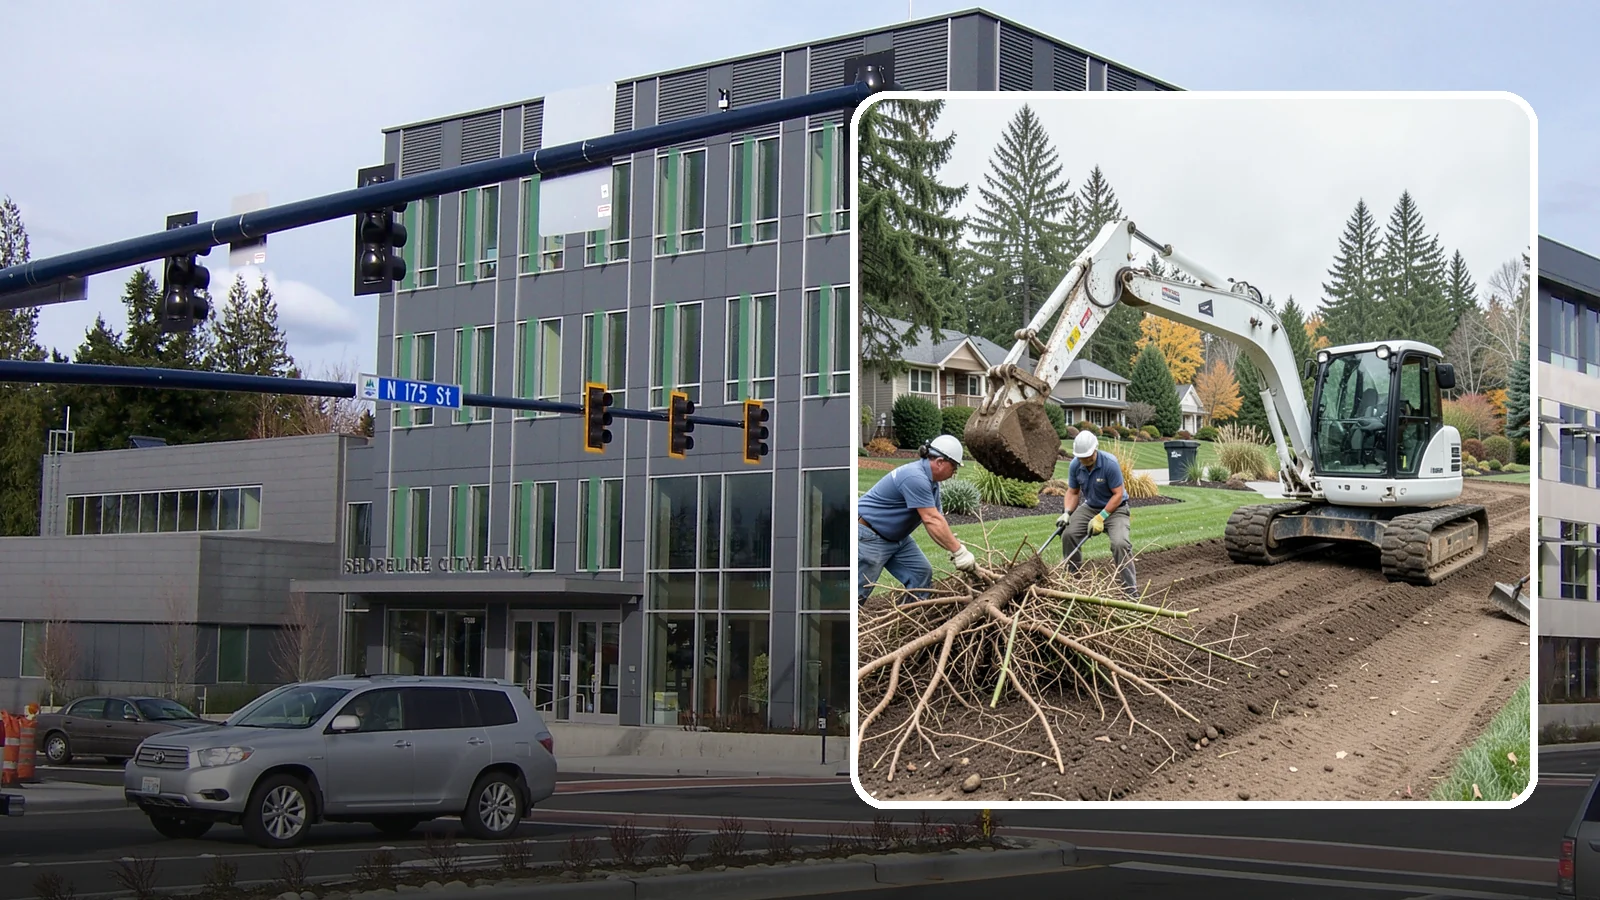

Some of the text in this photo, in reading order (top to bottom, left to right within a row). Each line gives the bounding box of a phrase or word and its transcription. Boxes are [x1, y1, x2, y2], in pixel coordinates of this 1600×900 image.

[387, 380, 451, 406] N 175 St
[344, 555, 525, 574] SHORELINE CITY HALL
